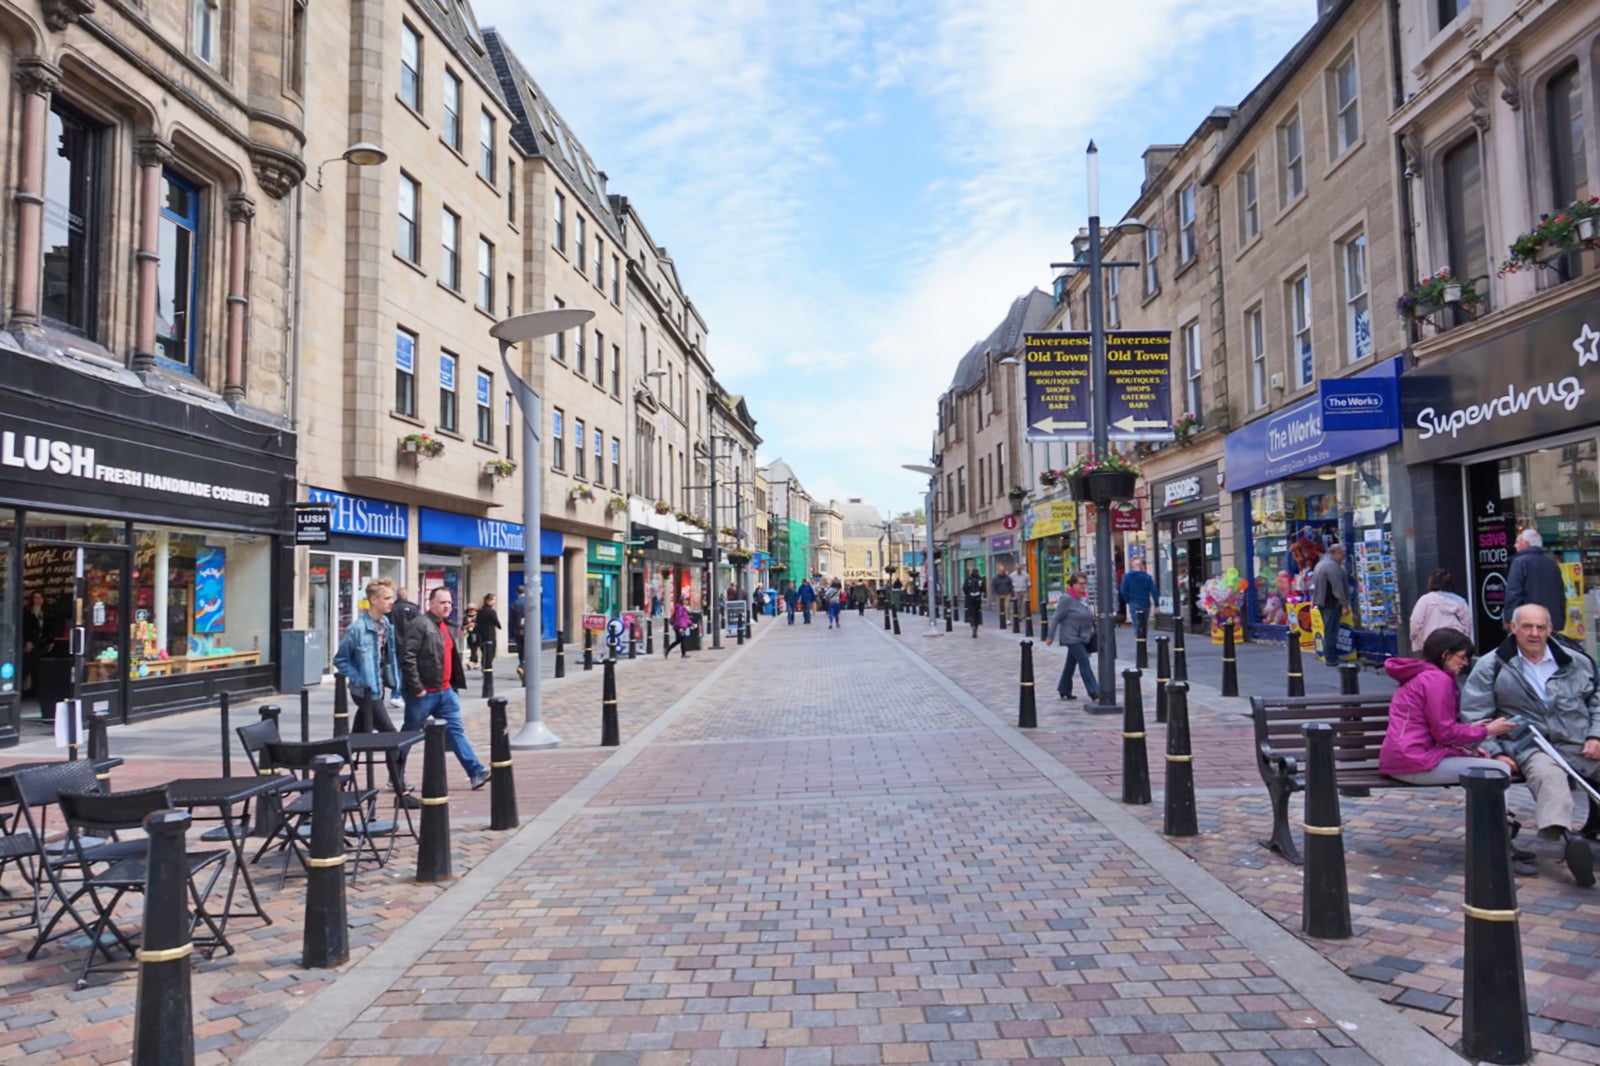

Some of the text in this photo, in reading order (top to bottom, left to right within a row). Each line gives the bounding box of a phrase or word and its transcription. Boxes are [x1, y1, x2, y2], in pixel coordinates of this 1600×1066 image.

[1026, 335, 1089, 346] Inverness
[1107, 334, 1170, 345] Inverness
[1028, 351, 1088, 362] Old Town
[1108, 350, 1168, 361] Old Town
[1329, 398, 1379, 406] The Works
[1417, 376, 1585, 440] Superdrug
[1268, 427, 1287, 453] The
[1, 430, 270, 507] LUSH FRESH HANDMADE COSMETICS
[298, 515, 326, 523] LUSH
[477, 519, 525, 552] WHSmit
[1478, 531, 1507, 547] save
[1479, 548, 1508, 563] more
[583, 616, 605, 625] Free
